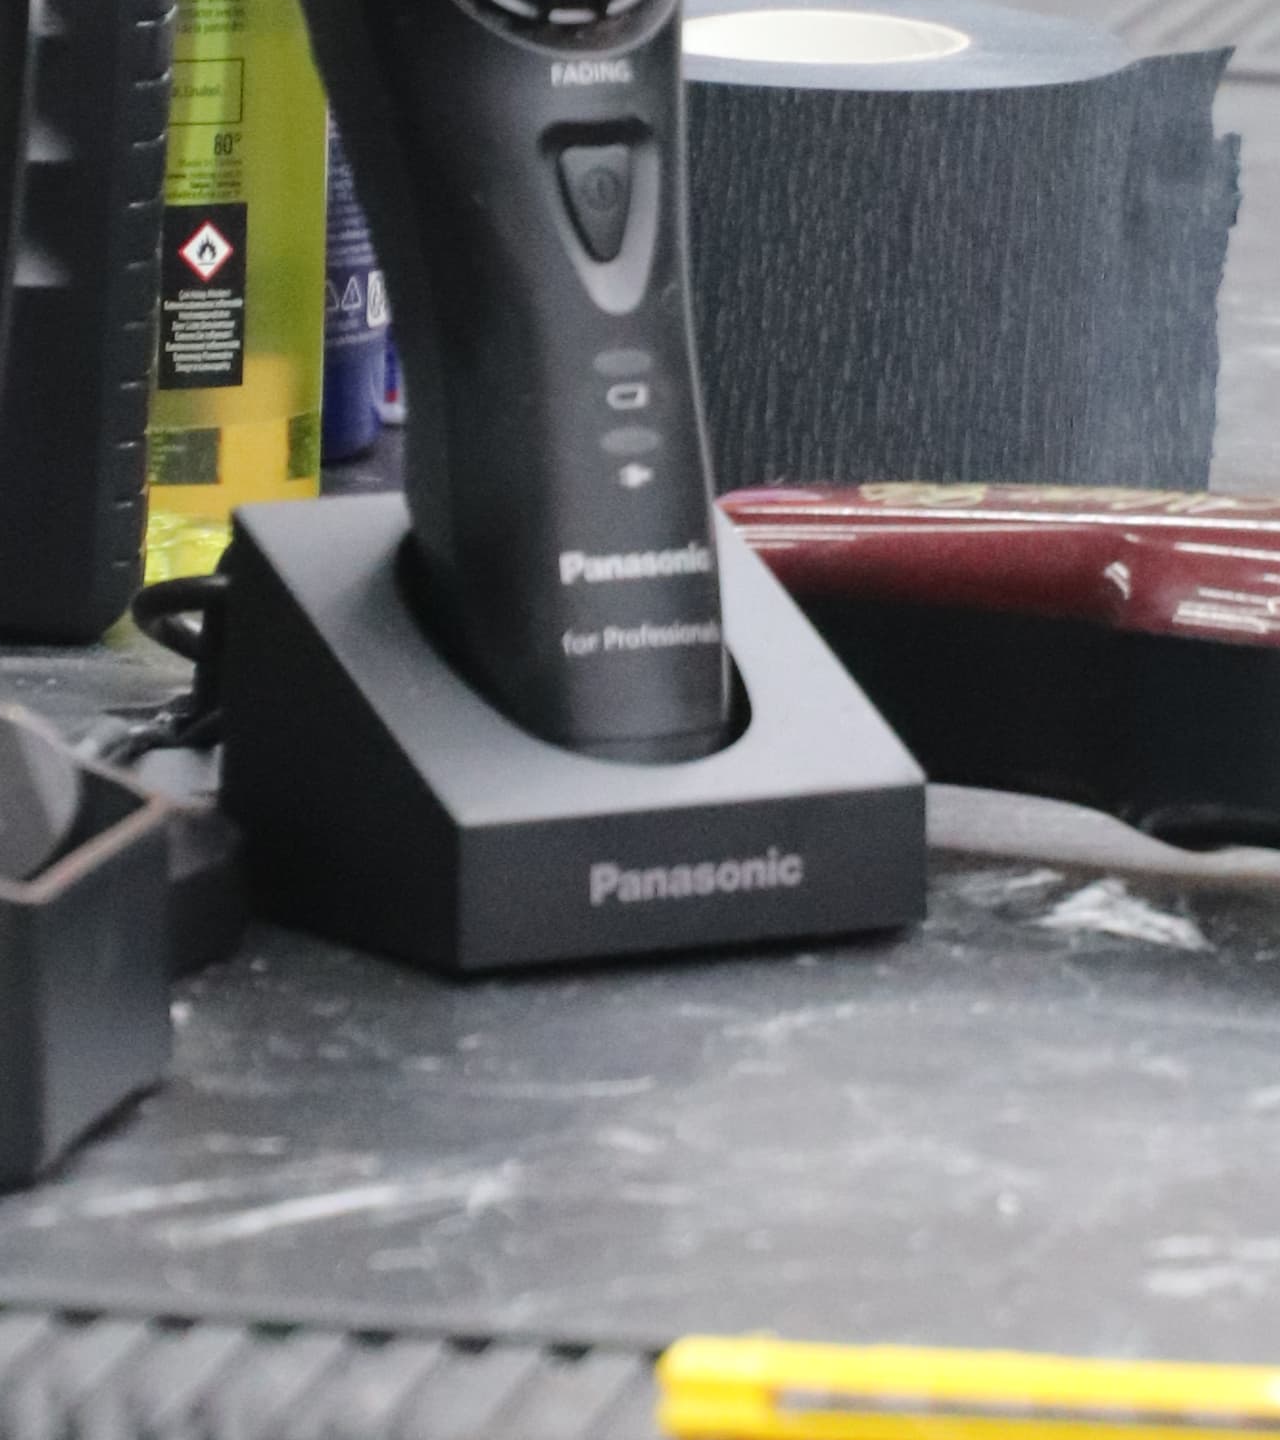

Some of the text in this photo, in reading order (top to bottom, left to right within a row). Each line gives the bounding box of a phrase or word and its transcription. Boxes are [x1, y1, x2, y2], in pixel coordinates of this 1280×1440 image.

[550, 59, 633, 88] FADING
[559, 541, 710, 586] Panasonic
[562, 629, 599, 658] for
[589, 848, 802, 908] Panasonic
